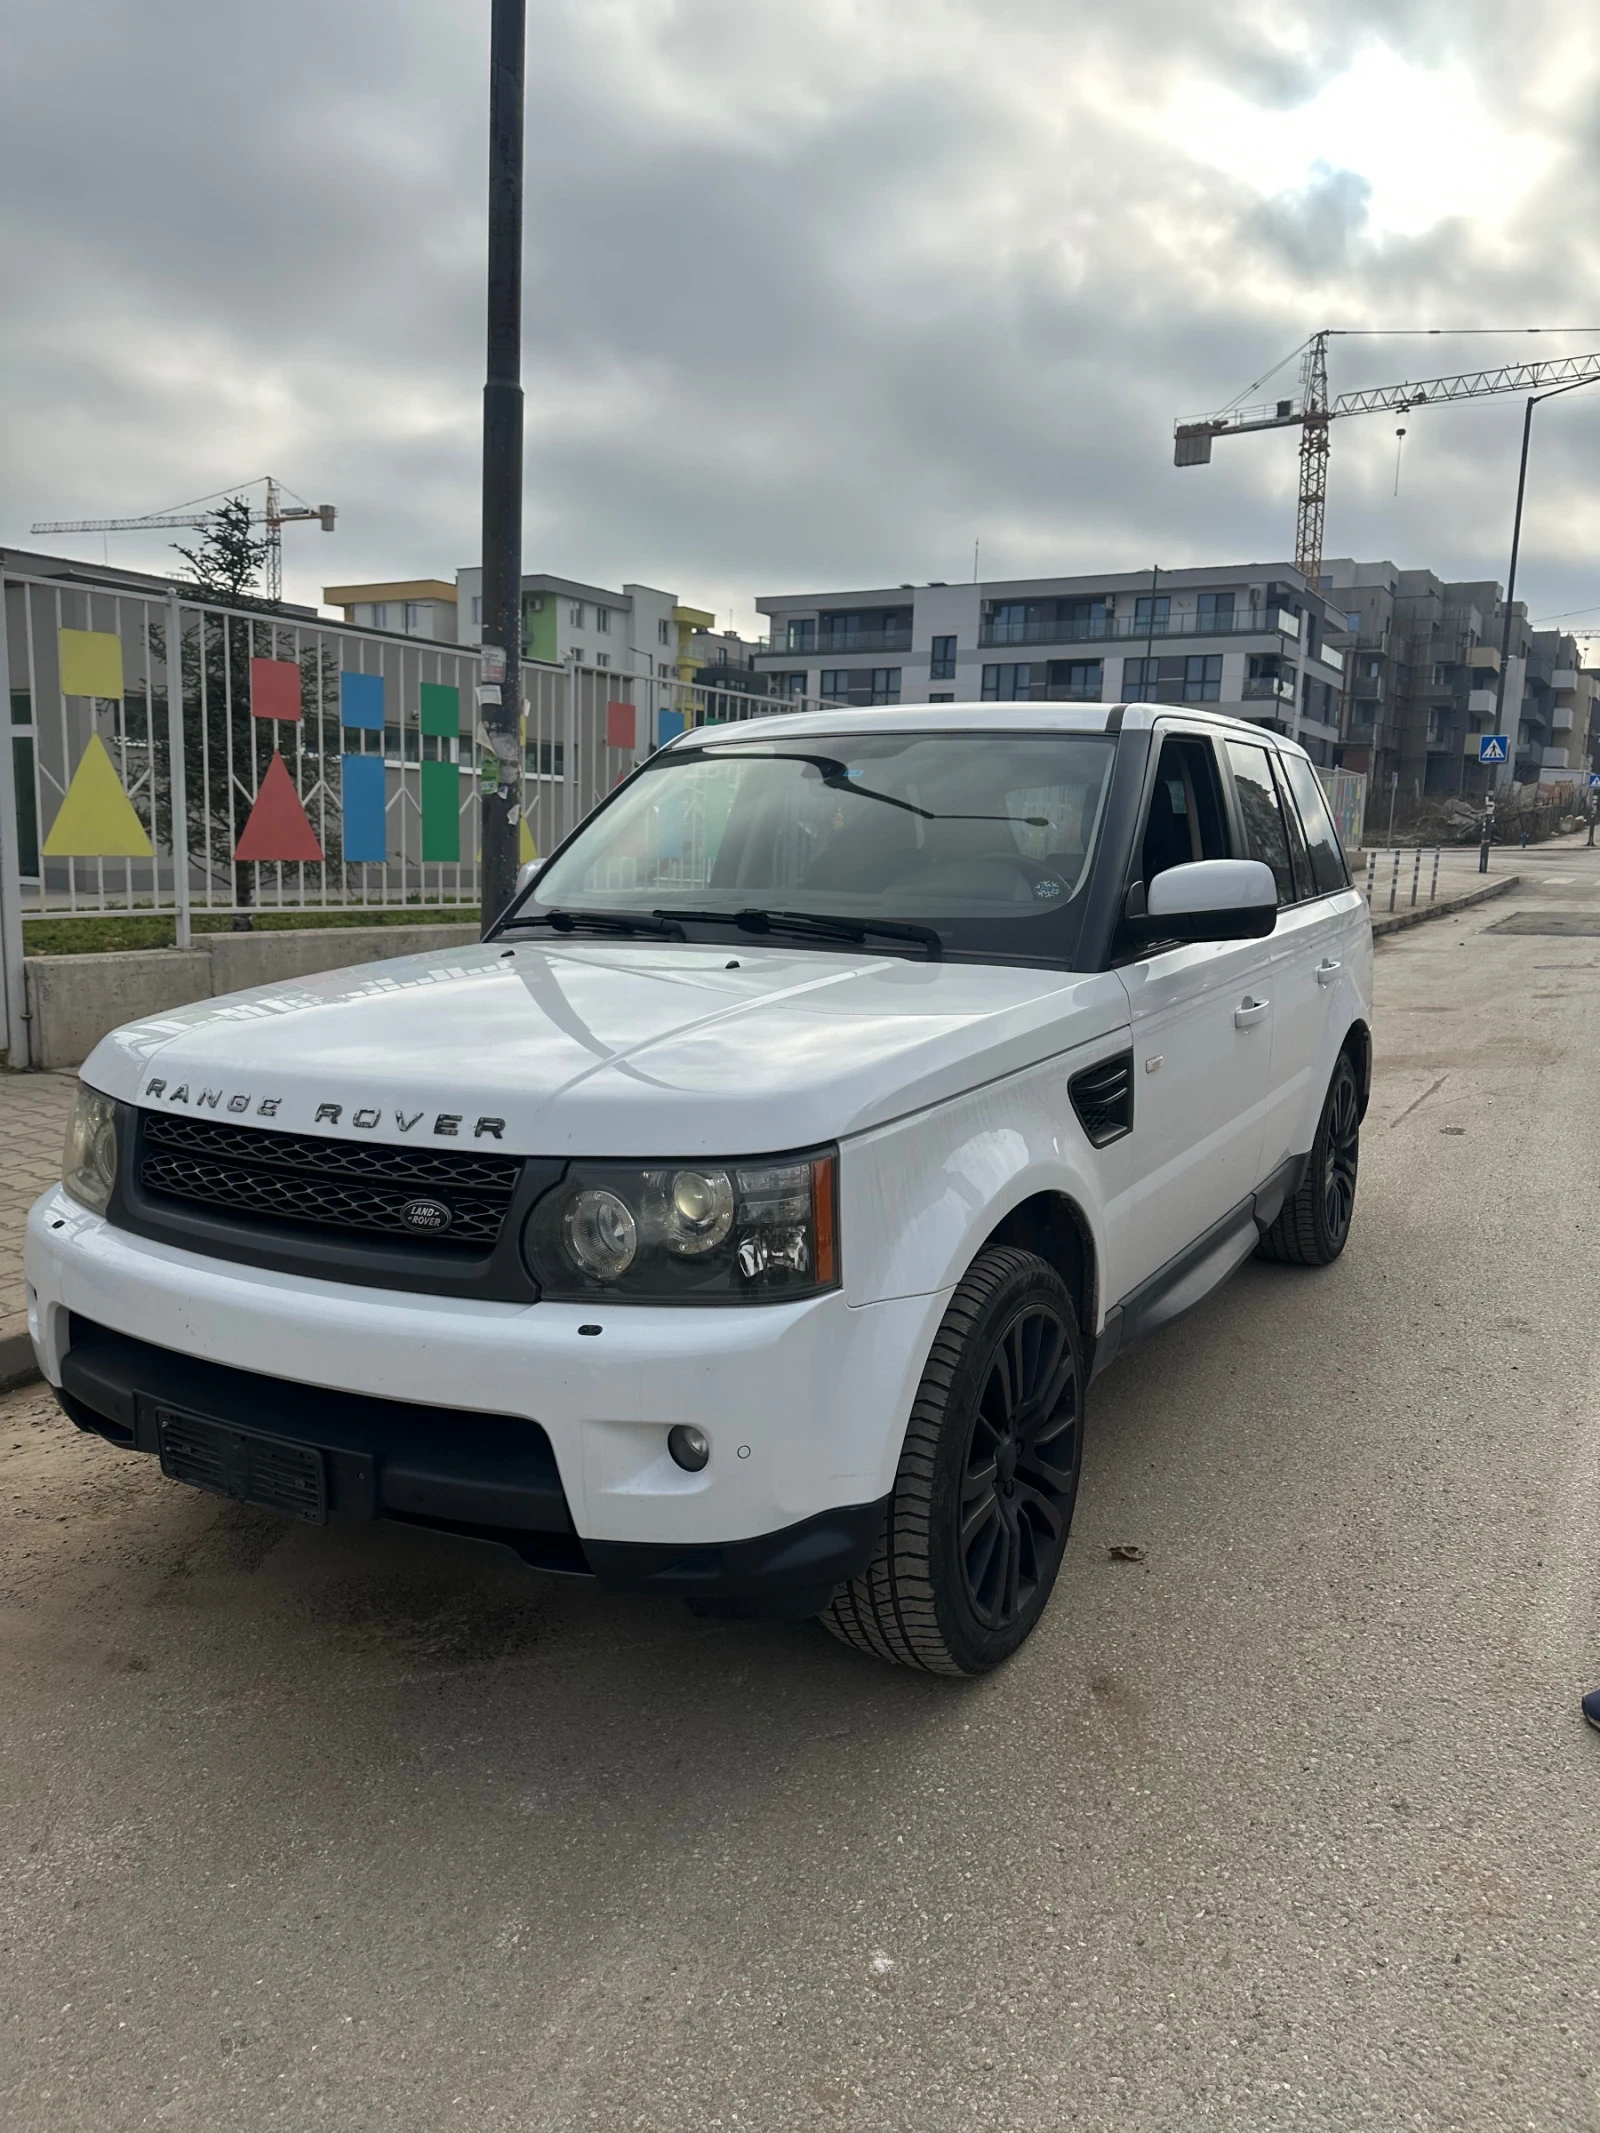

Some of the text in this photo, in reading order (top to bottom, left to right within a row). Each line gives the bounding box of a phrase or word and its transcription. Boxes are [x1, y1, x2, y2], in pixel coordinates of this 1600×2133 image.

[146, 1078, 506, 1139] RANGE ROVER
[410, 1206, 435, 1217] LAND
[411, 1215, 441, 1227] ROVER
